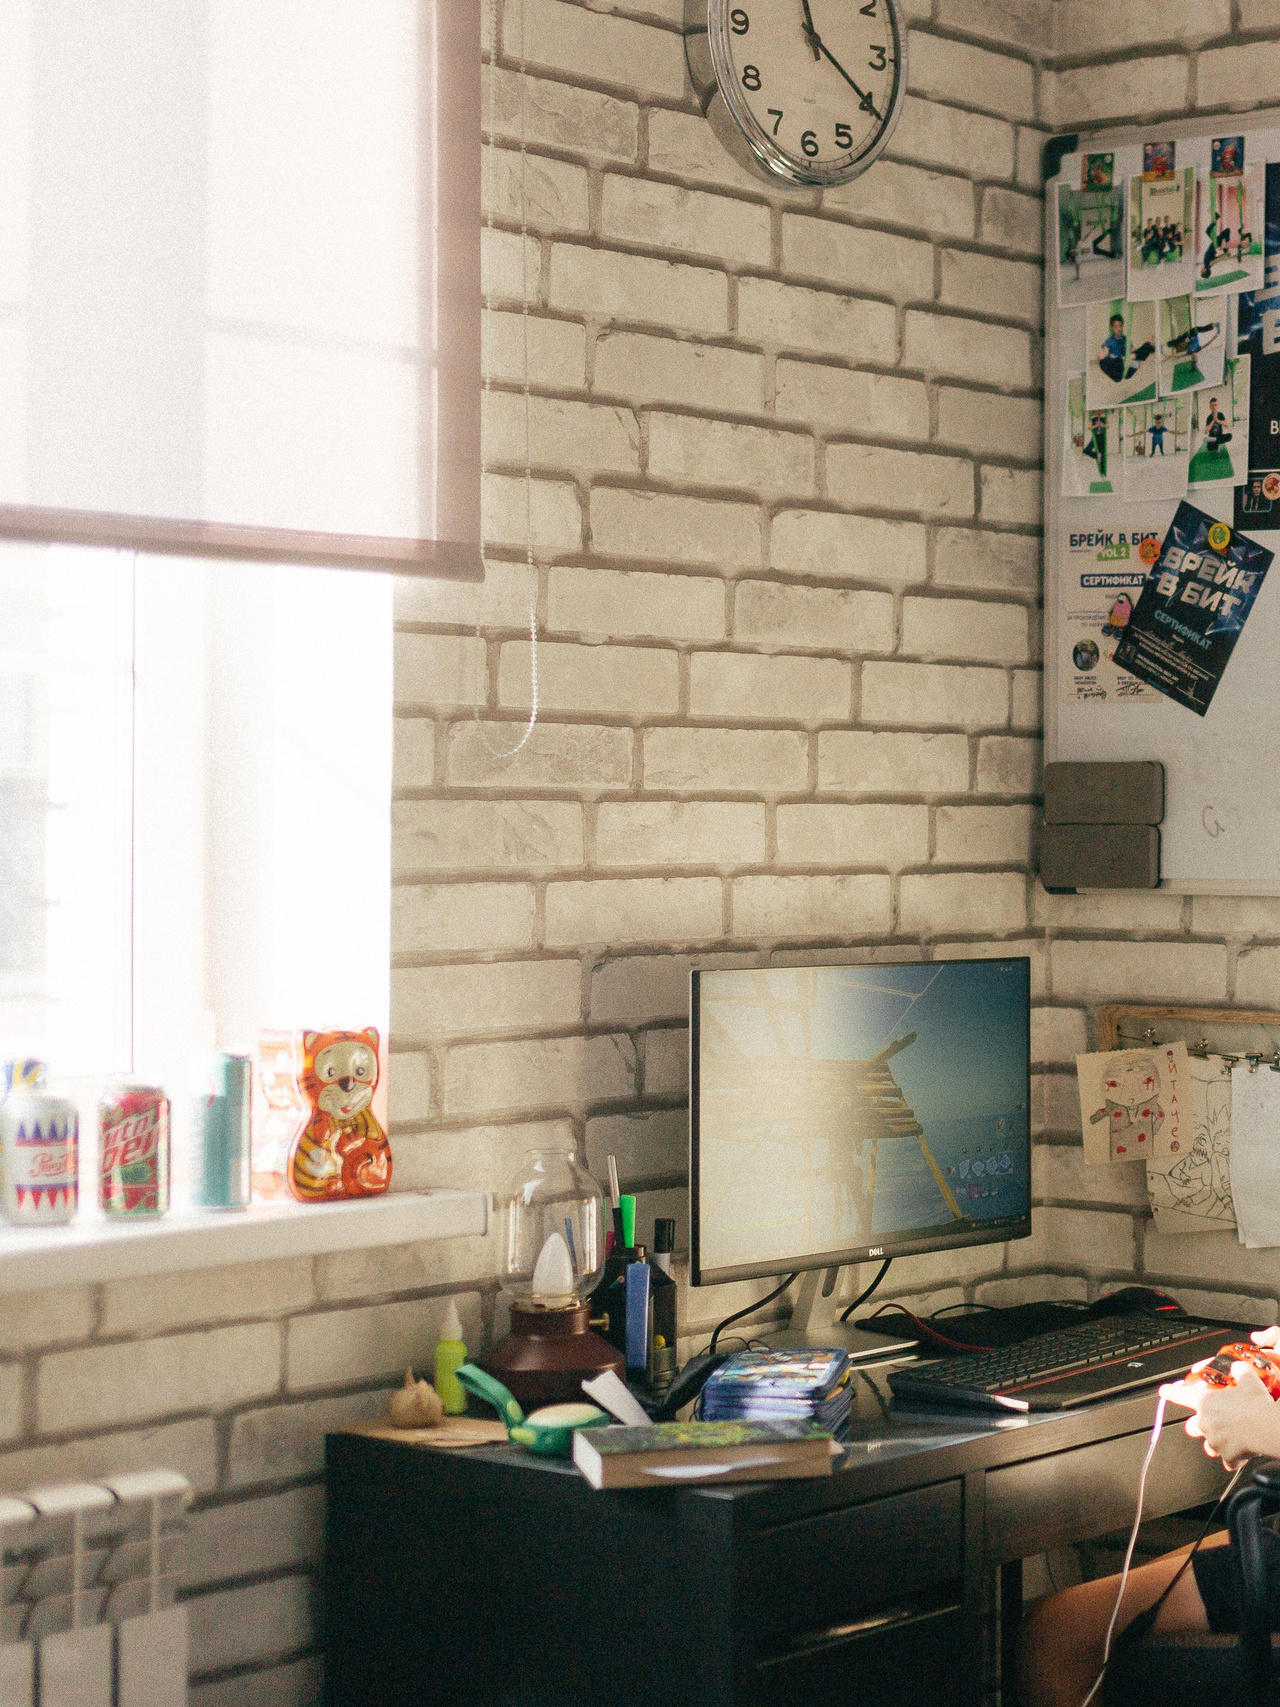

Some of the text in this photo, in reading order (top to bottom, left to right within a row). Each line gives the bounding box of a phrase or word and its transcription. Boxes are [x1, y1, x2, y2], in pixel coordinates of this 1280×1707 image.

[731, 9, 749, 35] 9
[868, 45, 887, 71] 3
[742, 65, 762, 91] 8
[768, 109, 783, 135] 7
[801, 131, 819, 157] 6
[834, 123, 853, 149] 5
[1070, 529, 1113, 547] БРЕЙК
[1121, 547, 1127, 557] 2
[1082, 575, 1144, 586] СЕРТИФИКАТ
[1156, 572, 1242, 616] В БИТ
[1154, 610, 1212, 650] СЕРТИФИКАТ
[869, 1247, 884, 1256] DELL
